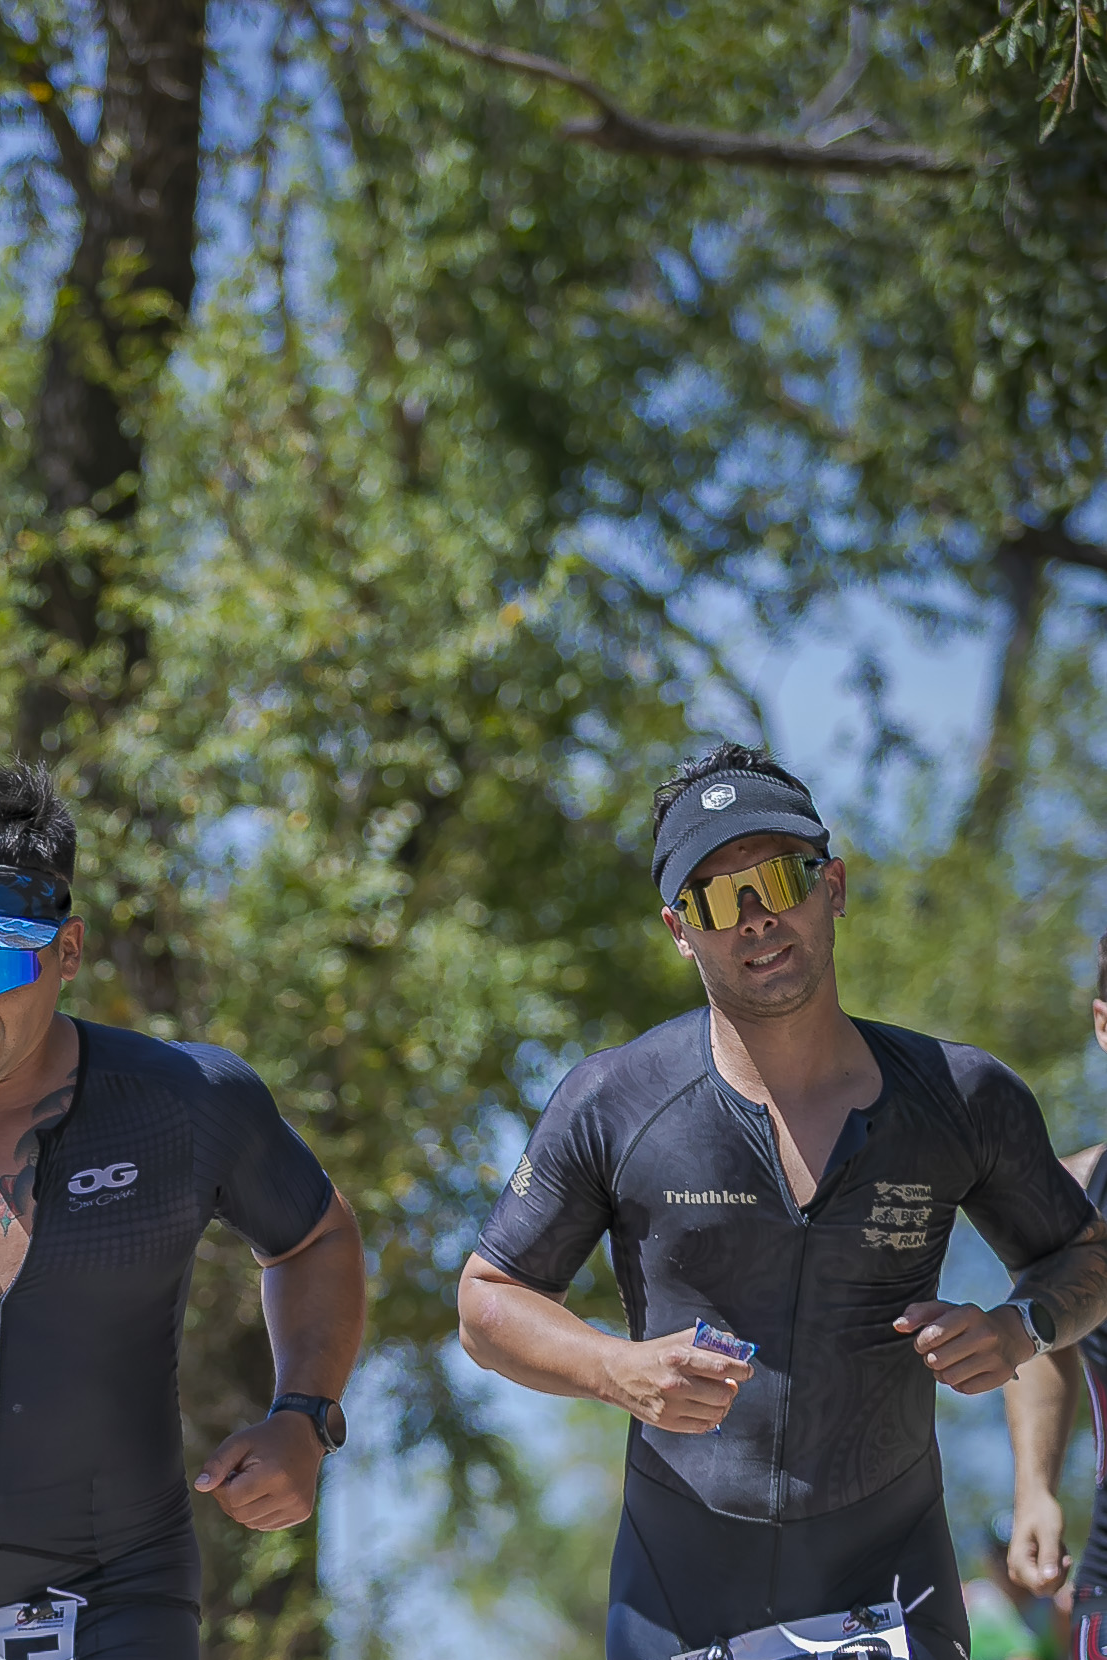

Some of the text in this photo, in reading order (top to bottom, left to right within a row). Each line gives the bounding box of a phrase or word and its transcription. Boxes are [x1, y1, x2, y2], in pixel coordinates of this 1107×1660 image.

[662, 1190, 758, 1204] Triathlete
[904, 1186, 931, 1198] SWIM
[900, 1210, 926, 1222] BIKE
[897, 1234, 924, 1246] RUN
